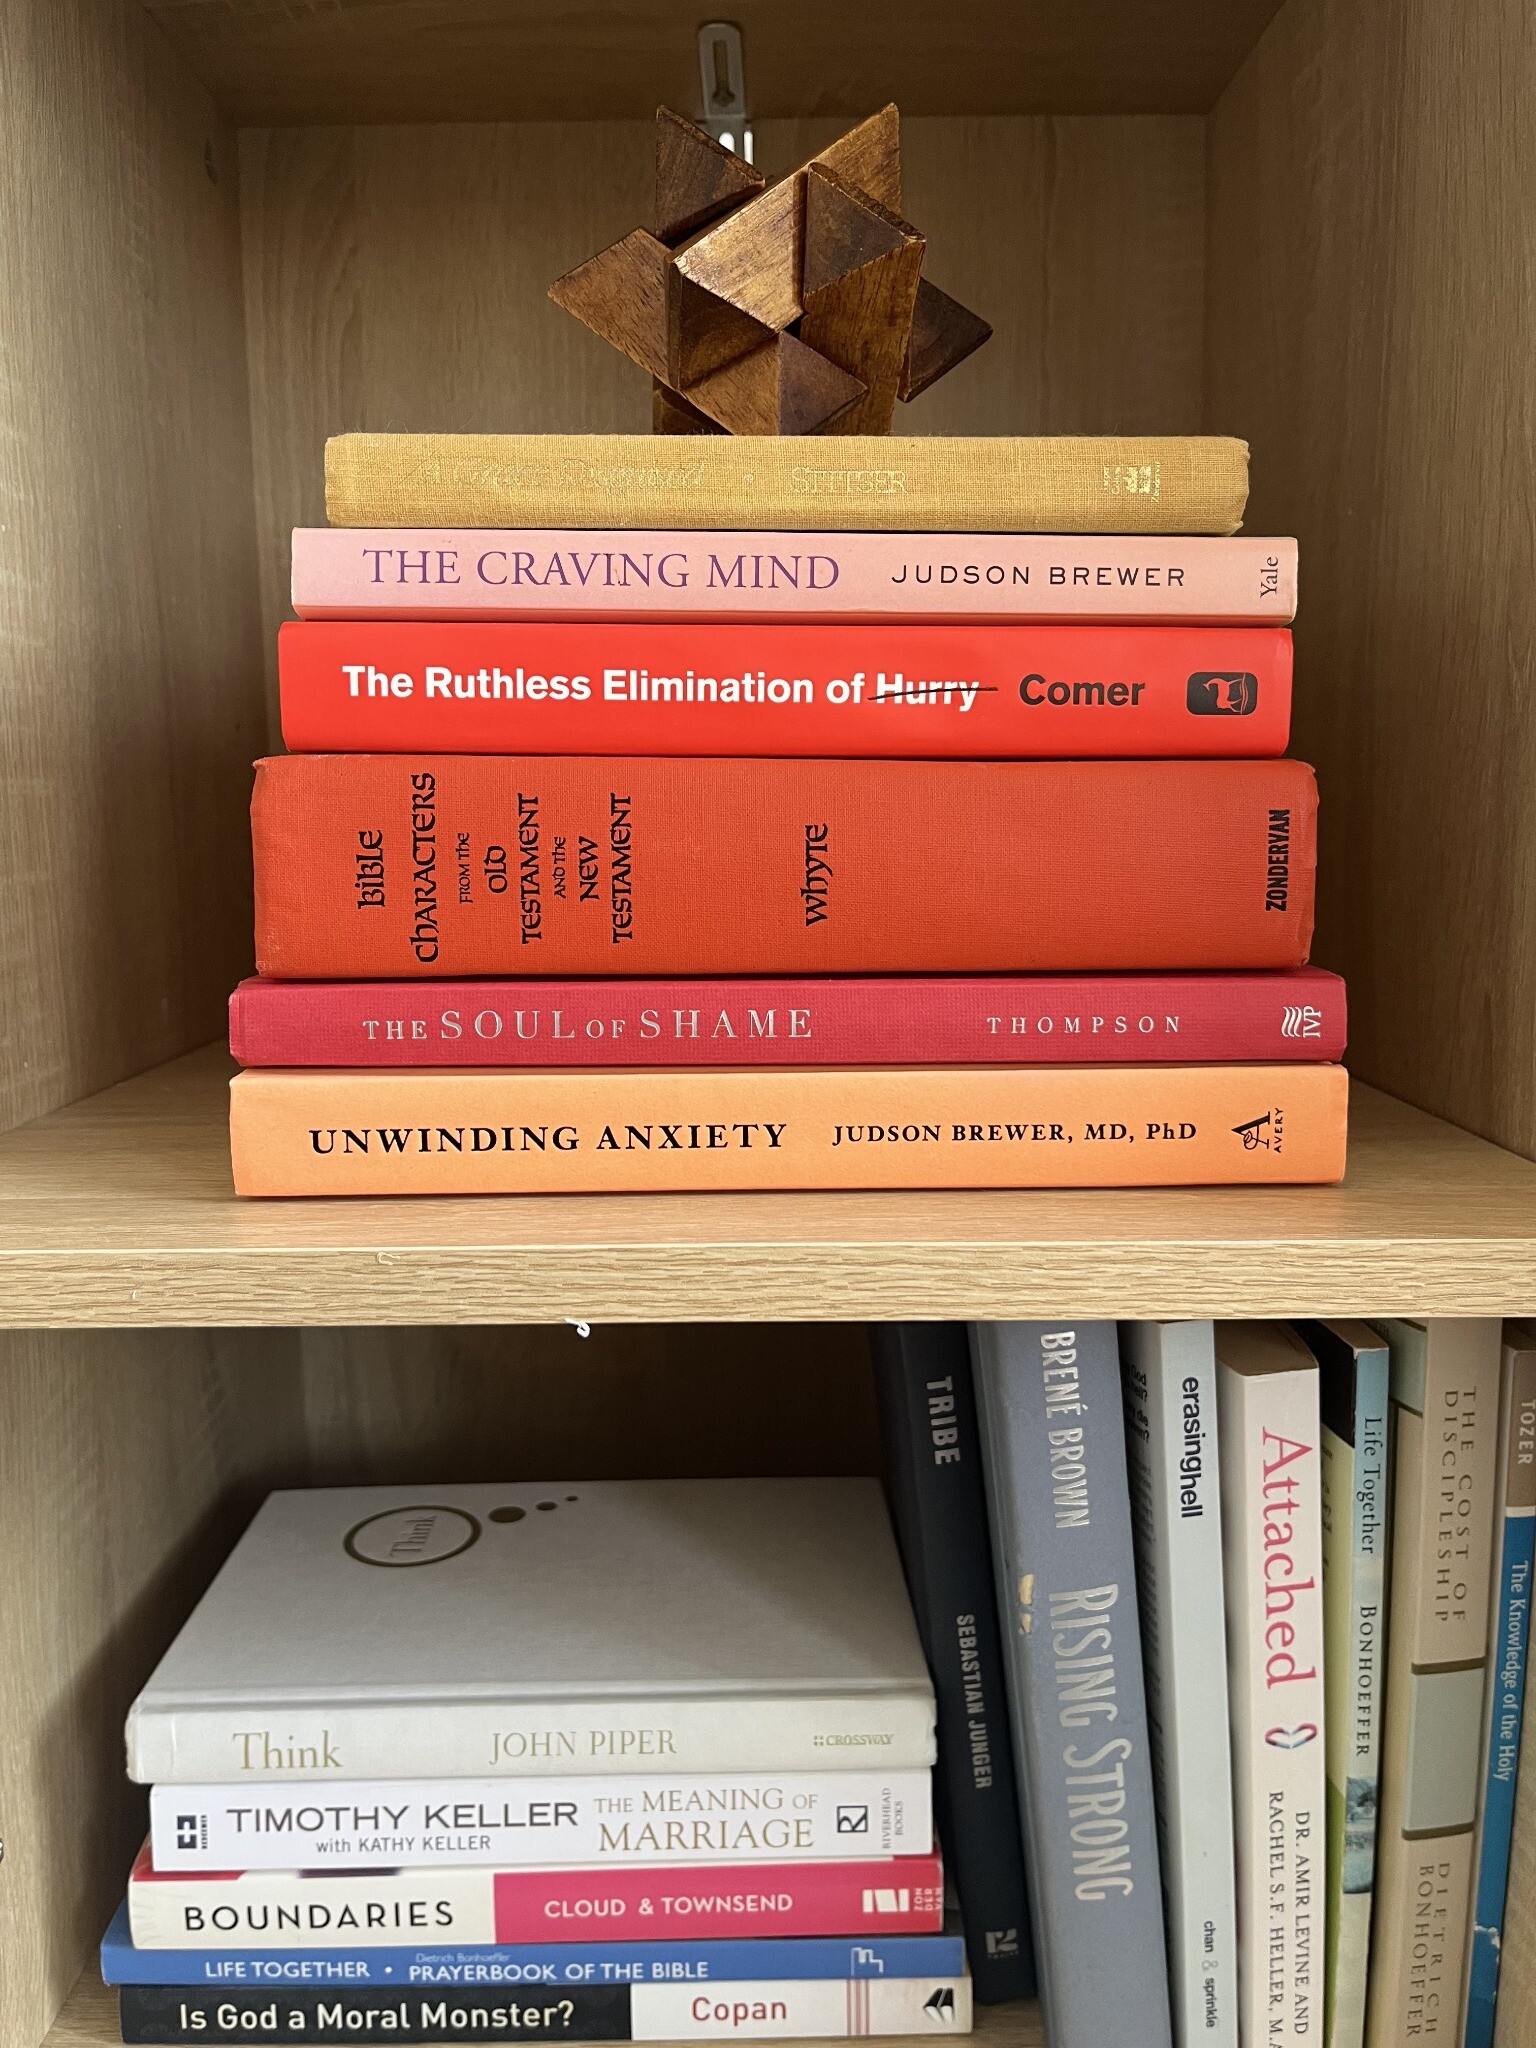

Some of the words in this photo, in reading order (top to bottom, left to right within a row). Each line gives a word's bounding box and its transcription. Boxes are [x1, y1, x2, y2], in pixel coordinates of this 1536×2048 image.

[363, 548, 461, 584] THE
[477, 551, 690, 588] CRAVING
[706, 553, 840, 590] MIND
[892, 564, 1030, 585] JUDSON
[1050, 567, 1185, 587] BREWER
[1260, 556, 1280, 599] Yale
[342, 665, 414, 698] The
[425, 666, 592, 700] Ruthless
[603, 668, 813, 703] Elimination
[826, 672, 866, 703] of
[876, 673, 979, 711] Hurry
[1019, 674, 1145, 707] Comer
[458, 860, 473, 904] FROM
[517, 793, 542, 944] TESTAMENT
[552, 865, 566, 899] AND
[578, 836, 600, 902] NEW
[610, 792, 632, 944] TESTAMENT
[1266, 809, 1291, 913] ZONDERVAN
[362, 1019, 428, 1041] THE
[440, 1009, 575, 1040] SOUL
[585, 1019, 626, 1039] OF
[639, 1008, 812, 1039] SHAME
[987, 1016, 1181, 1038] THOMPSON
[1303, 1005, 1322, 1038] IVP
[309, 1126, 580, 1154] UNWINDING
[596, 1123, 788, 1150] ANXIETY
[832, 1124, 941, 1147] JUDSON
[951, 1124, 1074, 1144] BREWER,
[1084, 1123, 1135, 1143] MD,
[1145, 1122, 1197, 1141] PhD
[1273, 1107, 1284, 1153] AVERY
[1040, 1330, 1088, 1419] BRENÉ
[927, 1376, 960, 1465] TRIBE
[1364, 1417, 1383, 1456] Life
[1462, 1386, 1477, 1451] THE
[1518, 1398, 1536, 1465] TOZER
[1180, 1376, 1206, 1518] erasinghell
[1048, 1428, 1089, 1528] BROWN
[1357, 1463, 1381, 1554] Together
[1435, 1390, 1458, 1622] DISCIPLESHIP
[1456, 1474, 1473, 1560] COST
[1262, 1427, 1317, 1689] Attached
[1511, 1560, 1529, 1593] The
[1453, 1583, 1467, 1621] OF
[1049, 1584, 1119, 1726] RISING
[1501, 1598, 1526, 1689] Knowledge
[956, 1614, 984, 1718] SEBASTIAN
[1356, 1605, 1378, 1757] BONHOEFFER
[1503, 1693, 1518, 1709] of
[489, 1731, 577, 1765] JOHN
[589, 1730, 677, 1756] PIPER
[826, 1733, 895, 1746] CROSSWAY
[1500, 1714, 1516, 1740] the
[232, 1730, 343, 1770] Think
[969, 1721, 992, 1789] JUNGER
[1493, 1745, 1515, 1782] Holy
[226, 1805, 410, 1833] TIMOTHY
[424, 1801, 578, 1829] KELLER
[594, 1797, 633, 1813] THE
[642, 1787, 784, 1812] MEANING
[792, 1793, 818, 1809] OF
[881, 1787, 892, 1849] RIVERHEAD
[1063, 1738, 1134, 1901] STRONG
[316, 1838, 351, 1854] with
[358, 1837, 415, 1853] KATHY
[422, 1835, 492, 1852] KELLER
[599, 1819, 814, 1852] MARRIAGE
[1269, 1791, 1285, 1879] RACHEL
[1295, 1811, 1310, 1847] DR.
[1295, 1854, 1310, 1908] AMIR
[185, 1900, 455, 1932] BOUNDARIES
[544, 1900, 626, 1918] CLOUD
[638, 1899, 654, 1916] &
[661, 1894, 793, 1915] TOWNSEND
[1203, 1920, 1215, 1954] chan
[1295, 1914, 1310, 1988] LEVINE
[1407, 1864, 1434, 2038] BONHOEFFER
[1426, 1862, 1450, 2034] DIETRICH
[205, 1961, 246, 1978] LIFE
[251, 1961, 370, 1978] TOGETHER
[409, 1964, 557, 1981] PRAYERBOOK
[565, 1963, 595, 1980] OF
[601, 1963, 644, 1979] THE
[652, 1962, 709, 1978] BIBLE
[1202, 1959, 1219, 1973] &
[1268, 1925, 1284, 2011] HELLER,
[180, 2004, 207, 2030] Is
[217, 2003, 278, 2030] God
[288, 2010, 306, 2030] a
[318, 2002, 410, 2030] Moral
[421, 2001, 574, 2029] Monster?
[691, 1996, 787, 2027] Copan
[1203, 1977, 1216, 2028] sprinkle
[1294, 1992, 1309, 2034] AND
